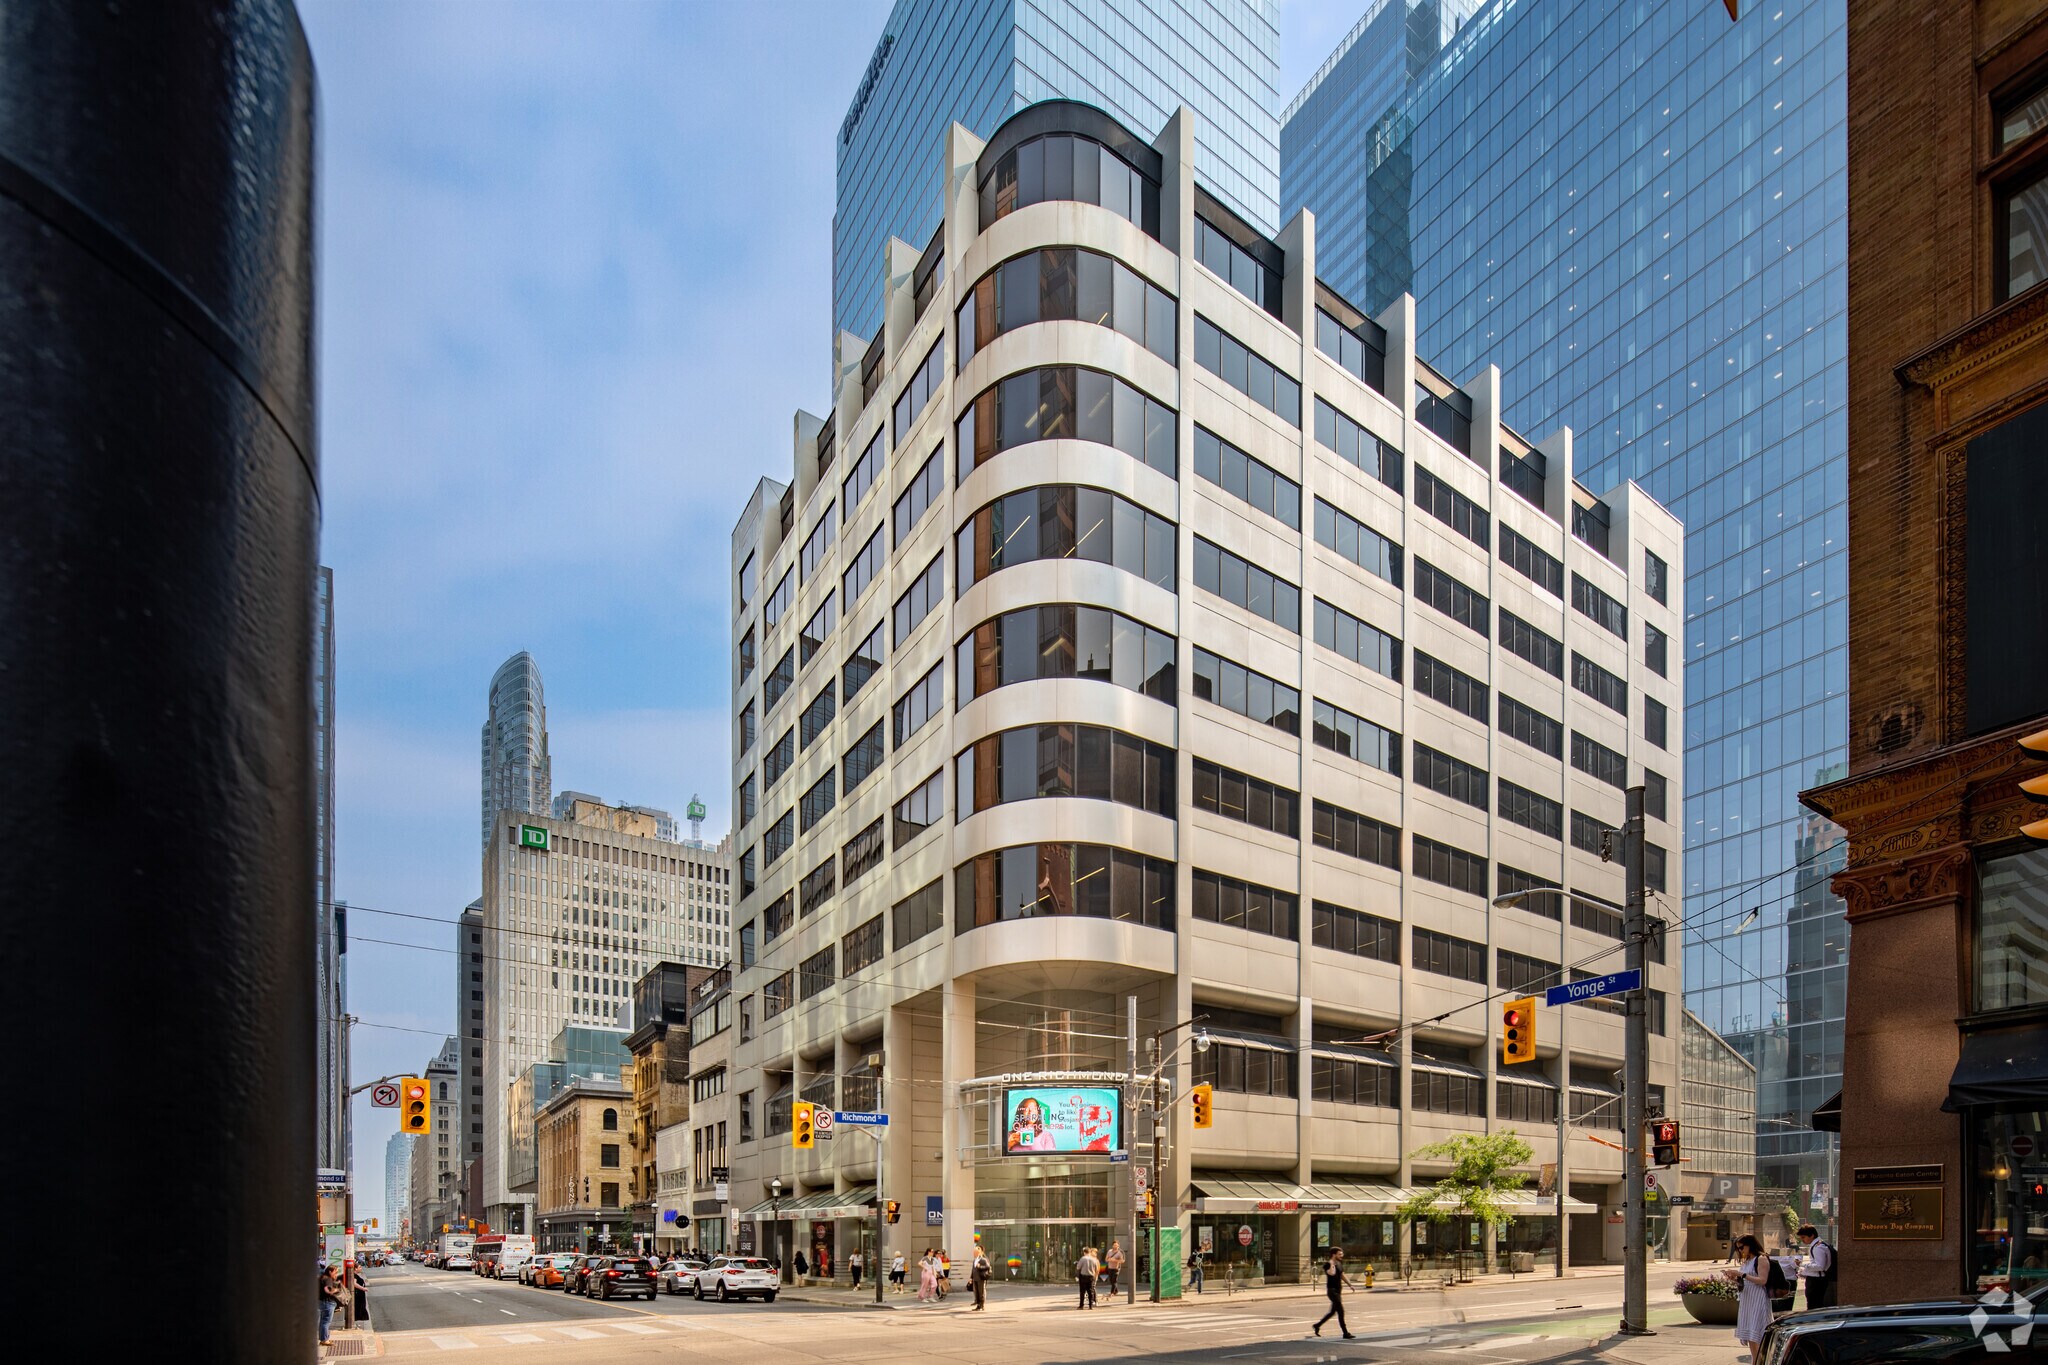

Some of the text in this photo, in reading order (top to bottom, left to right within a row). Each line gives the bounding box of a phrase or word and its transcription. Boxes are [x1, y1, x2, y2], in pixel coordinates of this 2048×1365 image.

[524, 828, 545, 845] TD
[1567, 976, 1616, 998] Yonge St
[1002, 1071, 1124, 1082] ONE RICHMOND
[841, 1113, 876, 1122] Richmond
[1015, 1113, 1065, 1122] SPARKLING
[1720, 1180, 1732, 1195] P
[1860, 1222, 1934, 1231] Hudson's Bay Company
